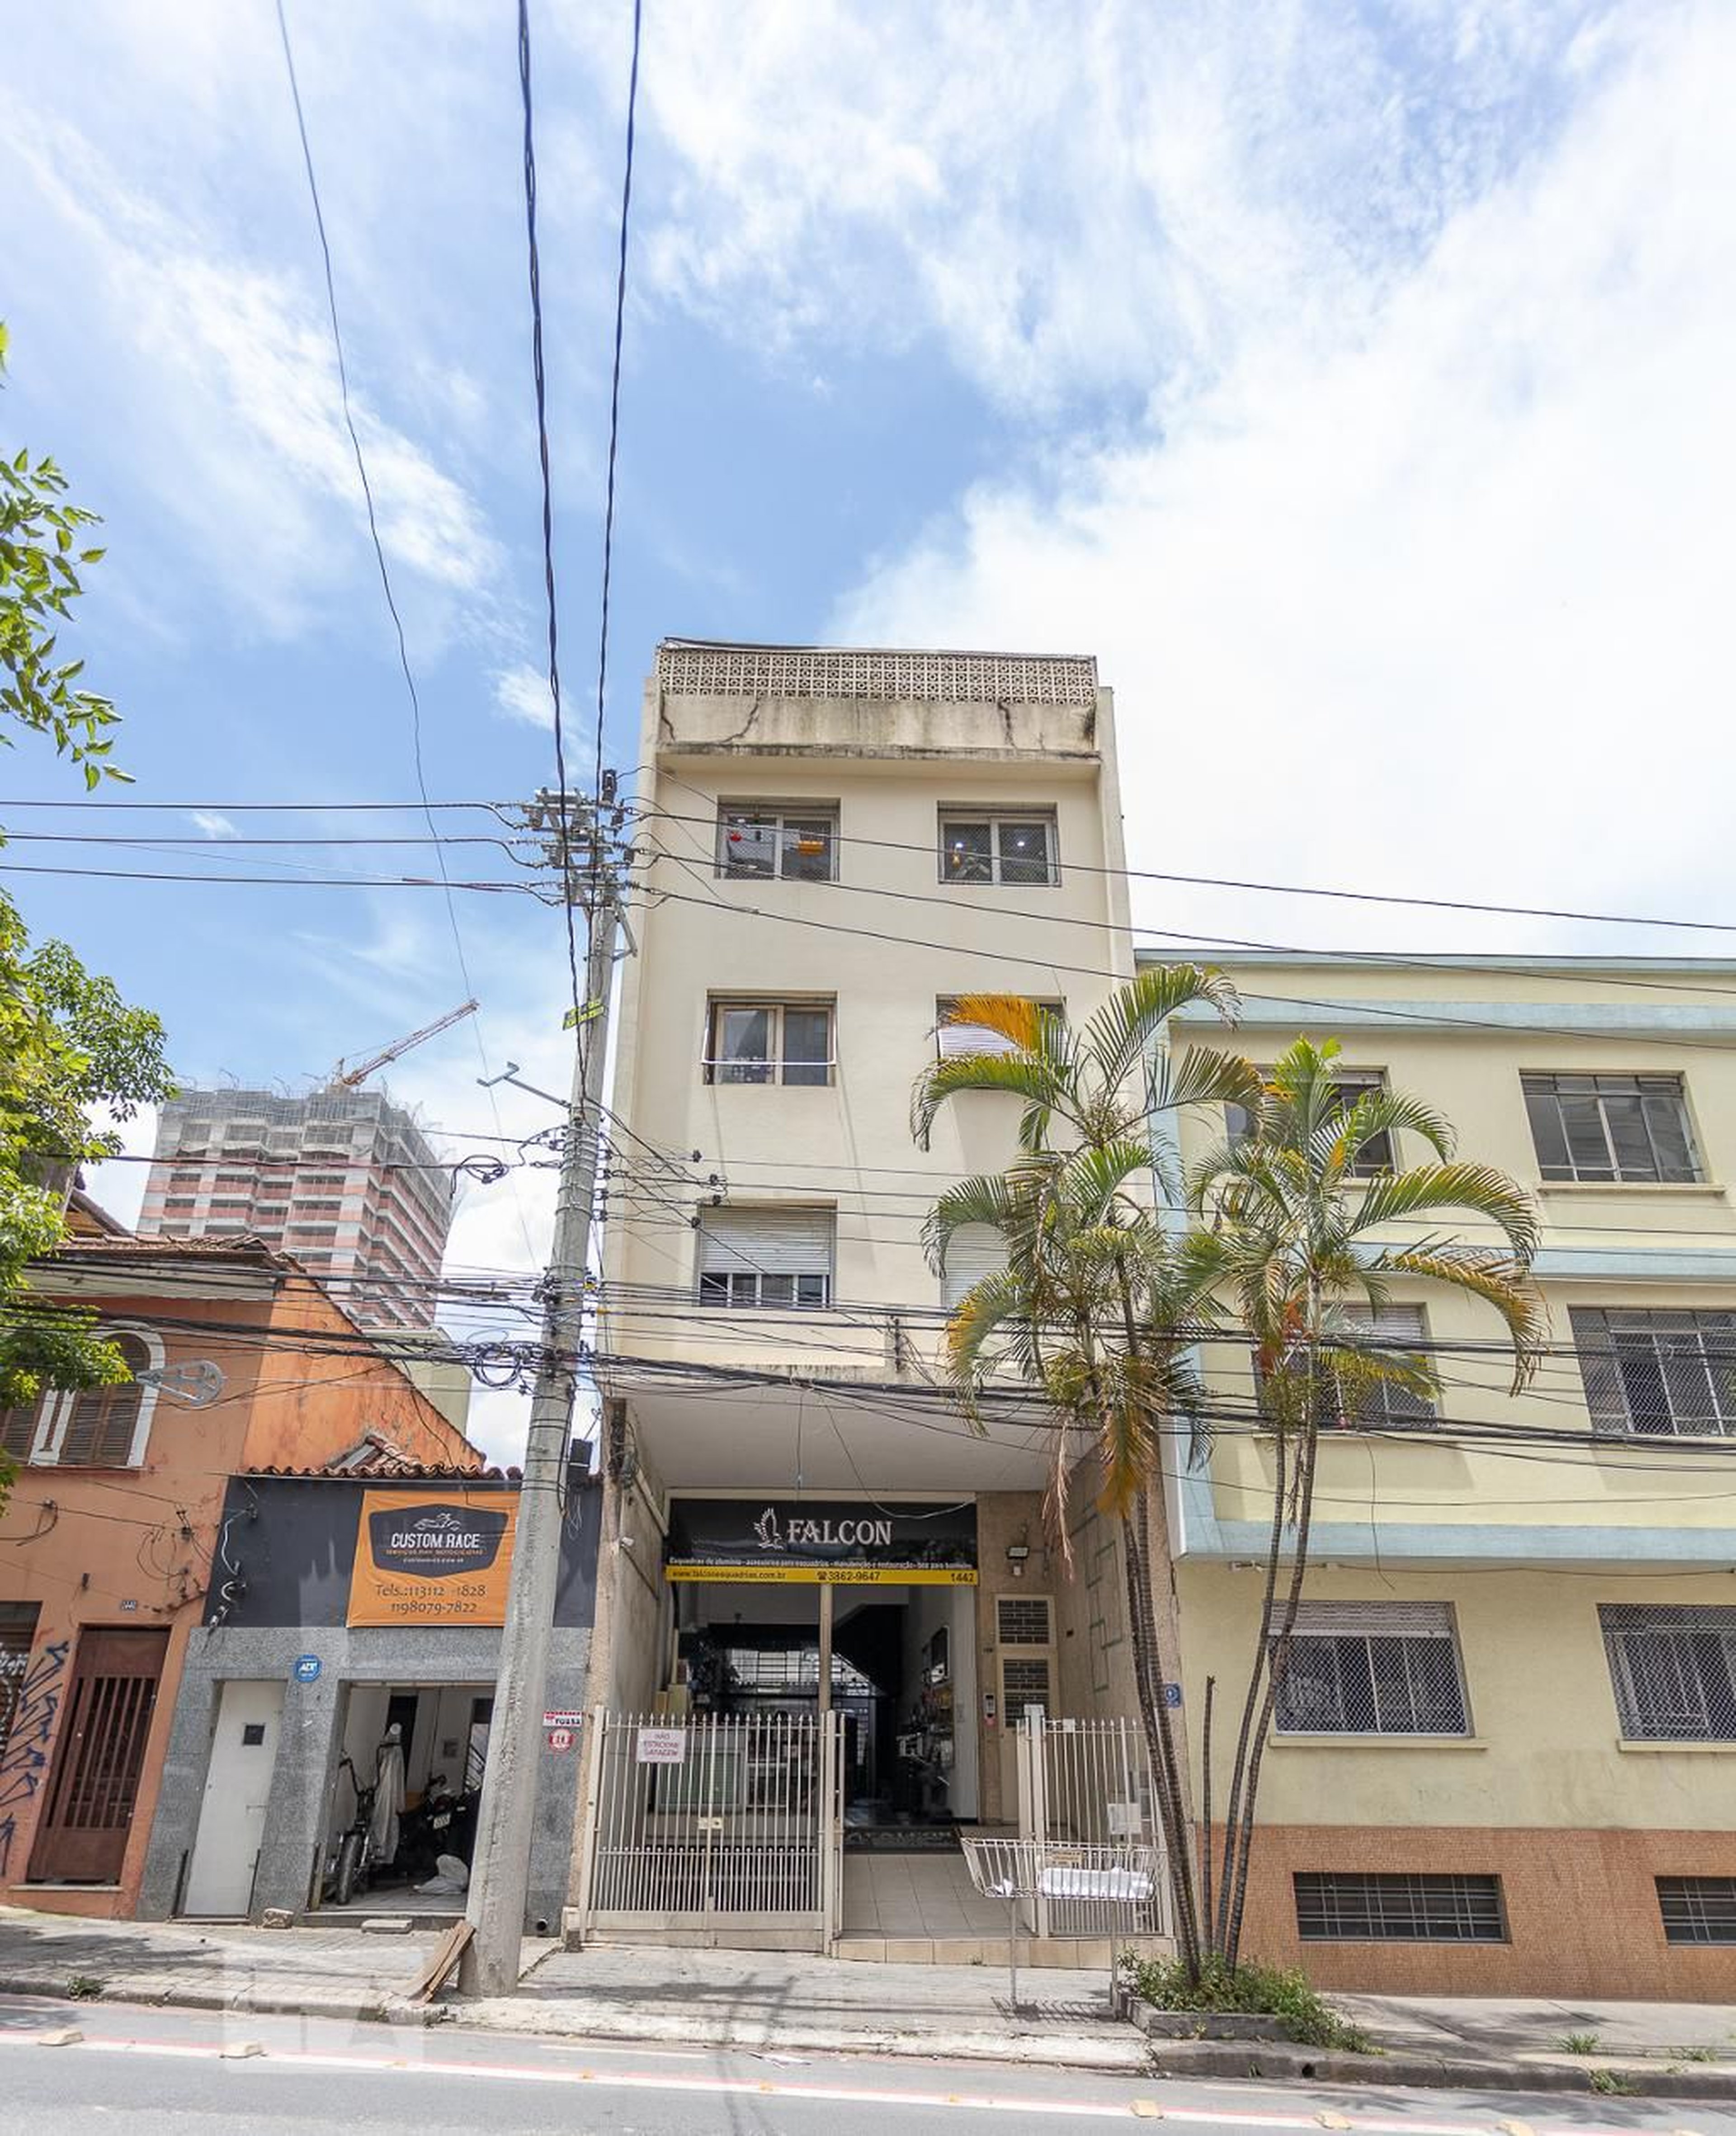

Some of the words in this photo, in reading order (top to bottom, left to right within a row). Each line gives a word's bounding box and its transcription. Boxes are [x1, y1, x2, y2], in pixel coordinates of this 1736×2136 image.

[391, 1532, 443, 1548] CUSTOM
[446, 1533, 481, 1548] RACE
[787, 1519, 892, 1545] FALCON
